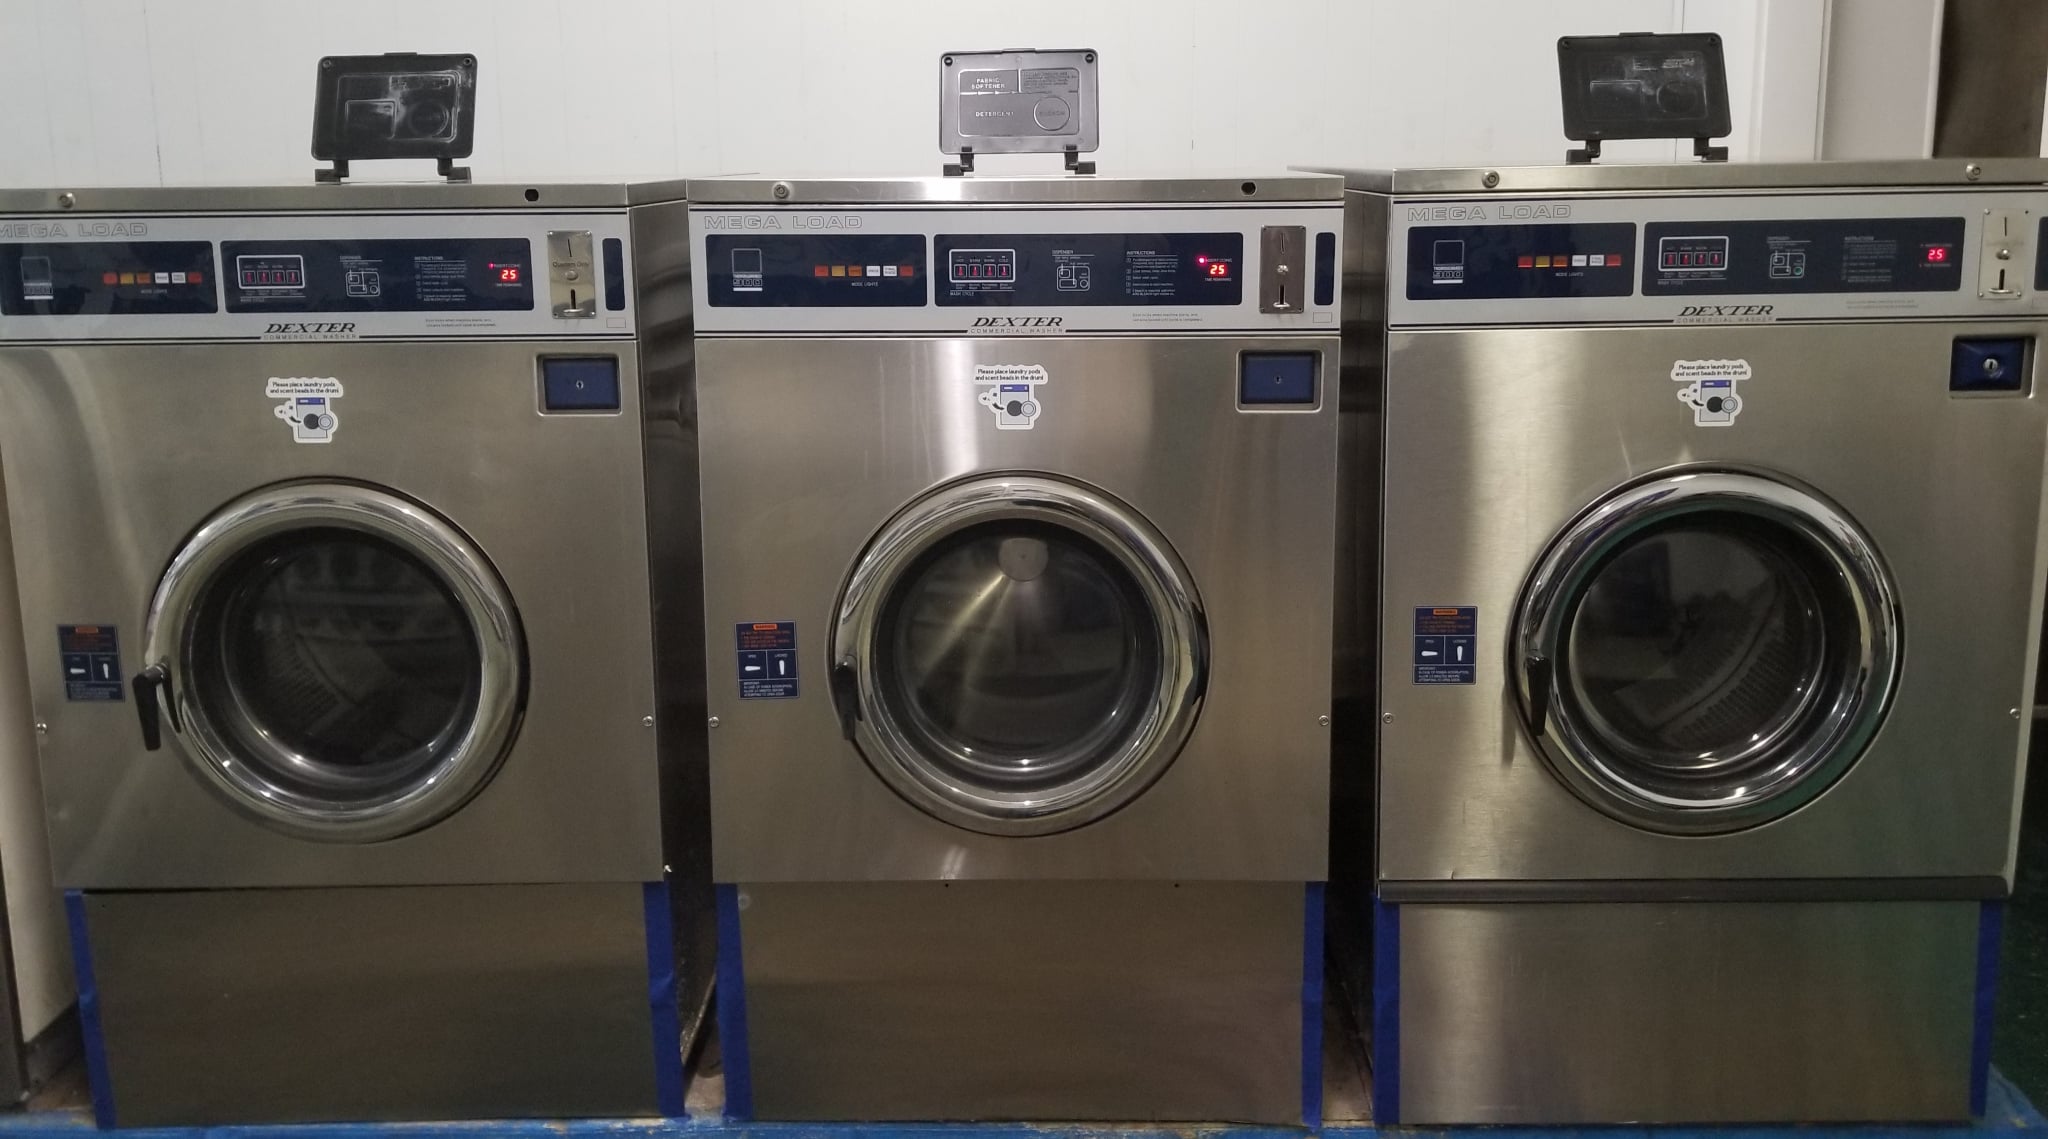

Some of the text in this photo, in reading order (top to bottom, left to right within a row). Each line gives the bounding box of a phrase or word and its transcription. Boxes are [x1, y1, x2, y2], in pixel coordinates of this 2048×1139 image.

[1408, 204, 1571, 221] MEGA LOAD
[704, 215, 863, 230] MEGA LOAD
[78, 222, 148, 237] LOAD
[1928, 248, 1944, 260] 25
[501, 269, 517, 280] 25
[1210, 264, 1225, 275] 25
[1678, 305, 1774, 316] DEXTER
[971, 316, 1063, 327] DEXTER
[264, 322, 356, 333] DEXTER
[1731, 362, 1744, 370] pods
